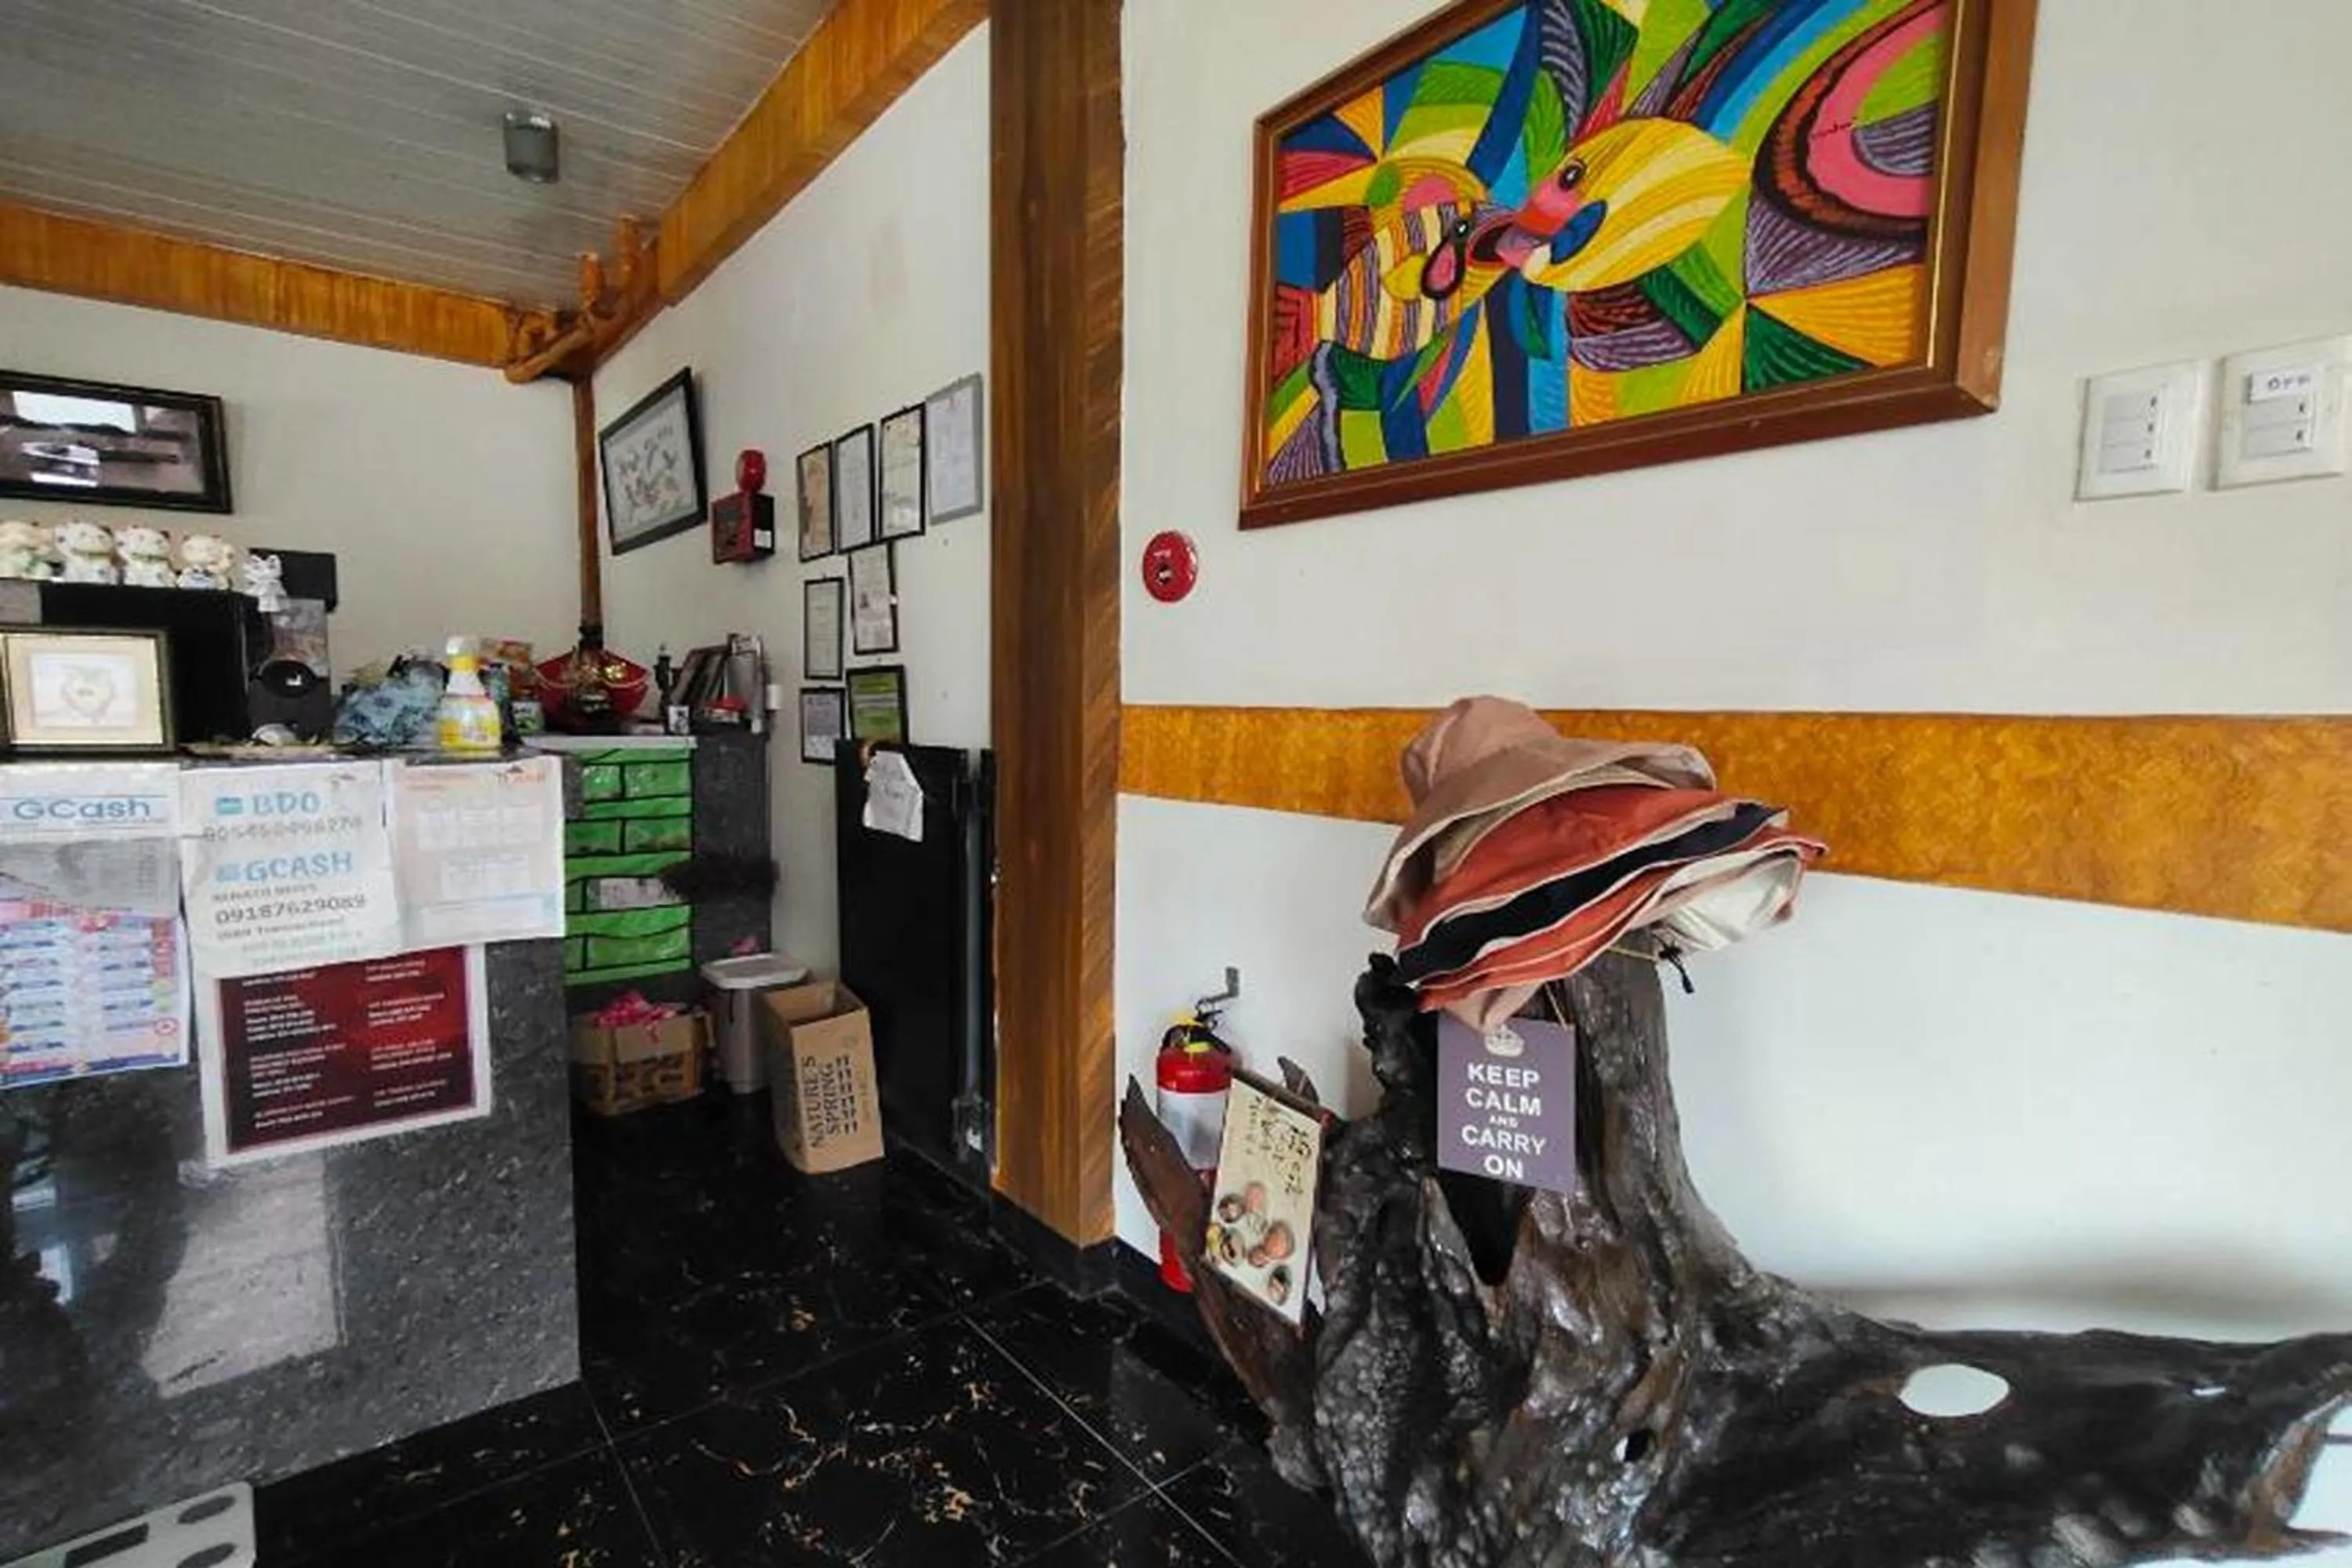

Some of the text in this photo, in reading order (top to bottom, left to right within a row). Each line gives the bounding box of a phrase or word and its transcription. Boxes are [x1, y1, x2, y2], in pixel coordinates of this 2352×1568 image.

[13, 797, 151, 820] GCash
[253, 791, 321, 815] BDO
[245, 851, 354, 882] GCASH
[1467, 1062, 1541, 1088] KEEP
[821, 1063, 840, 1135] SPRING
[1465, 1087, 1541, 1116] CALM
[1490, 1115, 1519, 1128] AND
[1461, 1124, 1546, 1155] CARRY
[1483, 1154, 1524, 1179] ON
